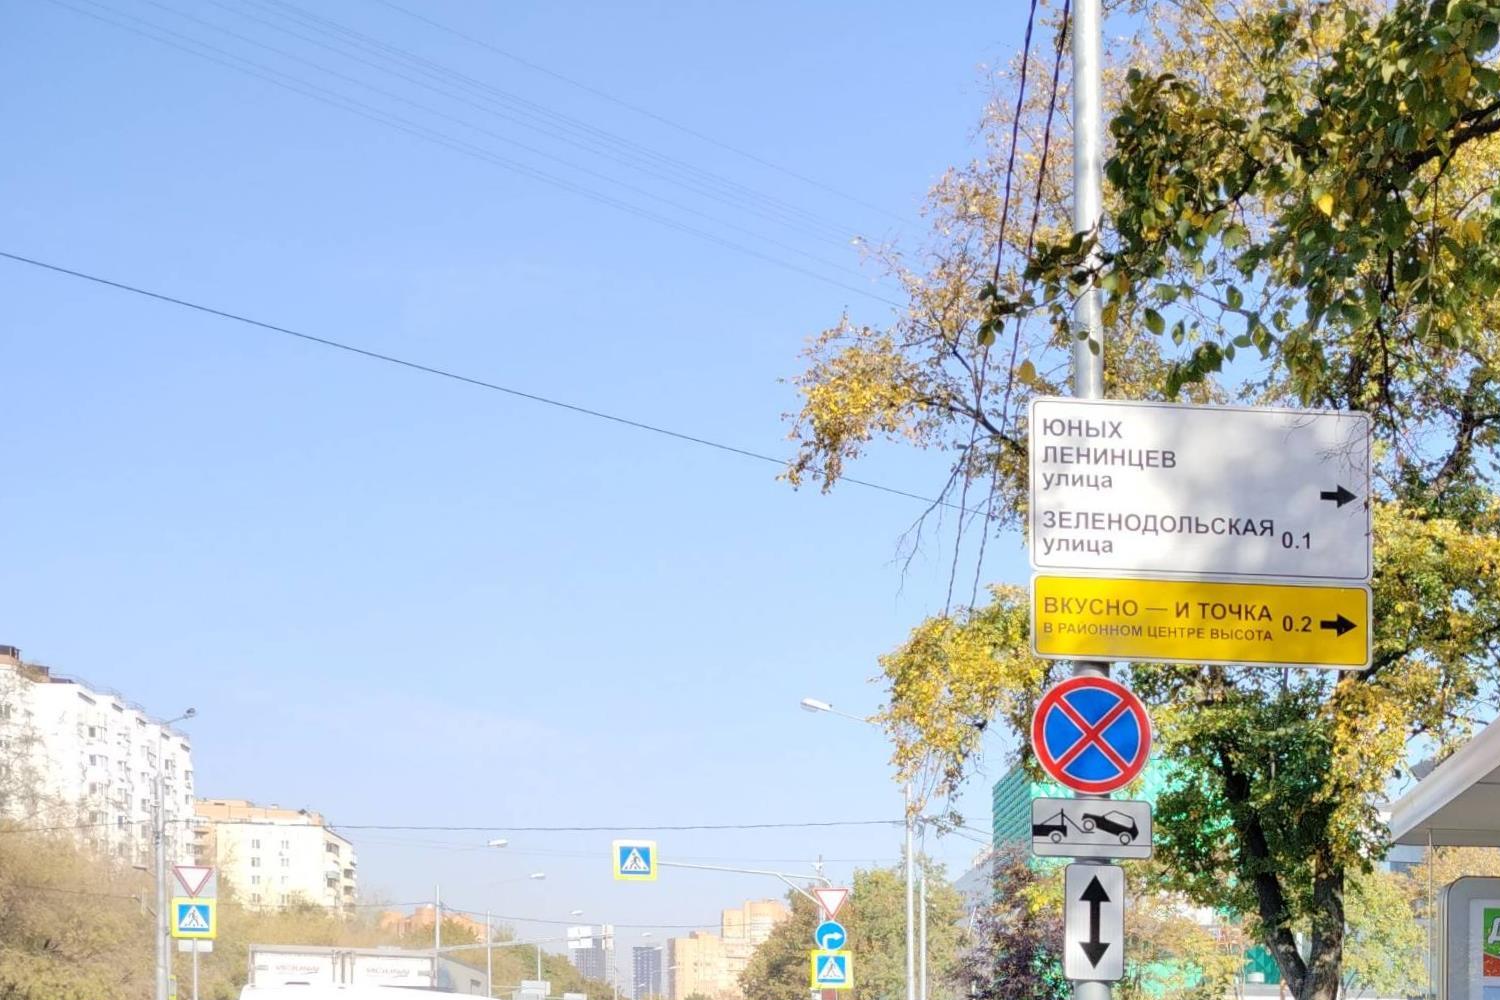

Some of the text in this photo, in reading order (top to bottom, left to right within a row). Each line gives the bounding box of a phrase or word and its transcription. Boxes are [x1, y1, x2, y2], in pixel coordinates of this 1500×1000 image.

[1043, 418, 1122, 439] ЮНЫХ
[1042, 446, 1176, 469] ЛЕНИНЦЕВ
[1042, 474, 1113, 490] улица
[1043, 511, 1274, 537] ЗЕЛЕНОДОЛЬСКАЯ
[1042, 538, 1113, 555] улица
[1282, 531, 1311, 549] 0.1
[1044, 597, 1138, 616] ВКУСНО
[1175, 601, 1190, 618] И
[1198, 603, 1273, 622] ТОЧКА
[1044, 621, 1273, 641] В РАЙОННОМ ЦЕНТРЕ ВЫСОТА
[1283, 615, 1312, 632] 0.2
